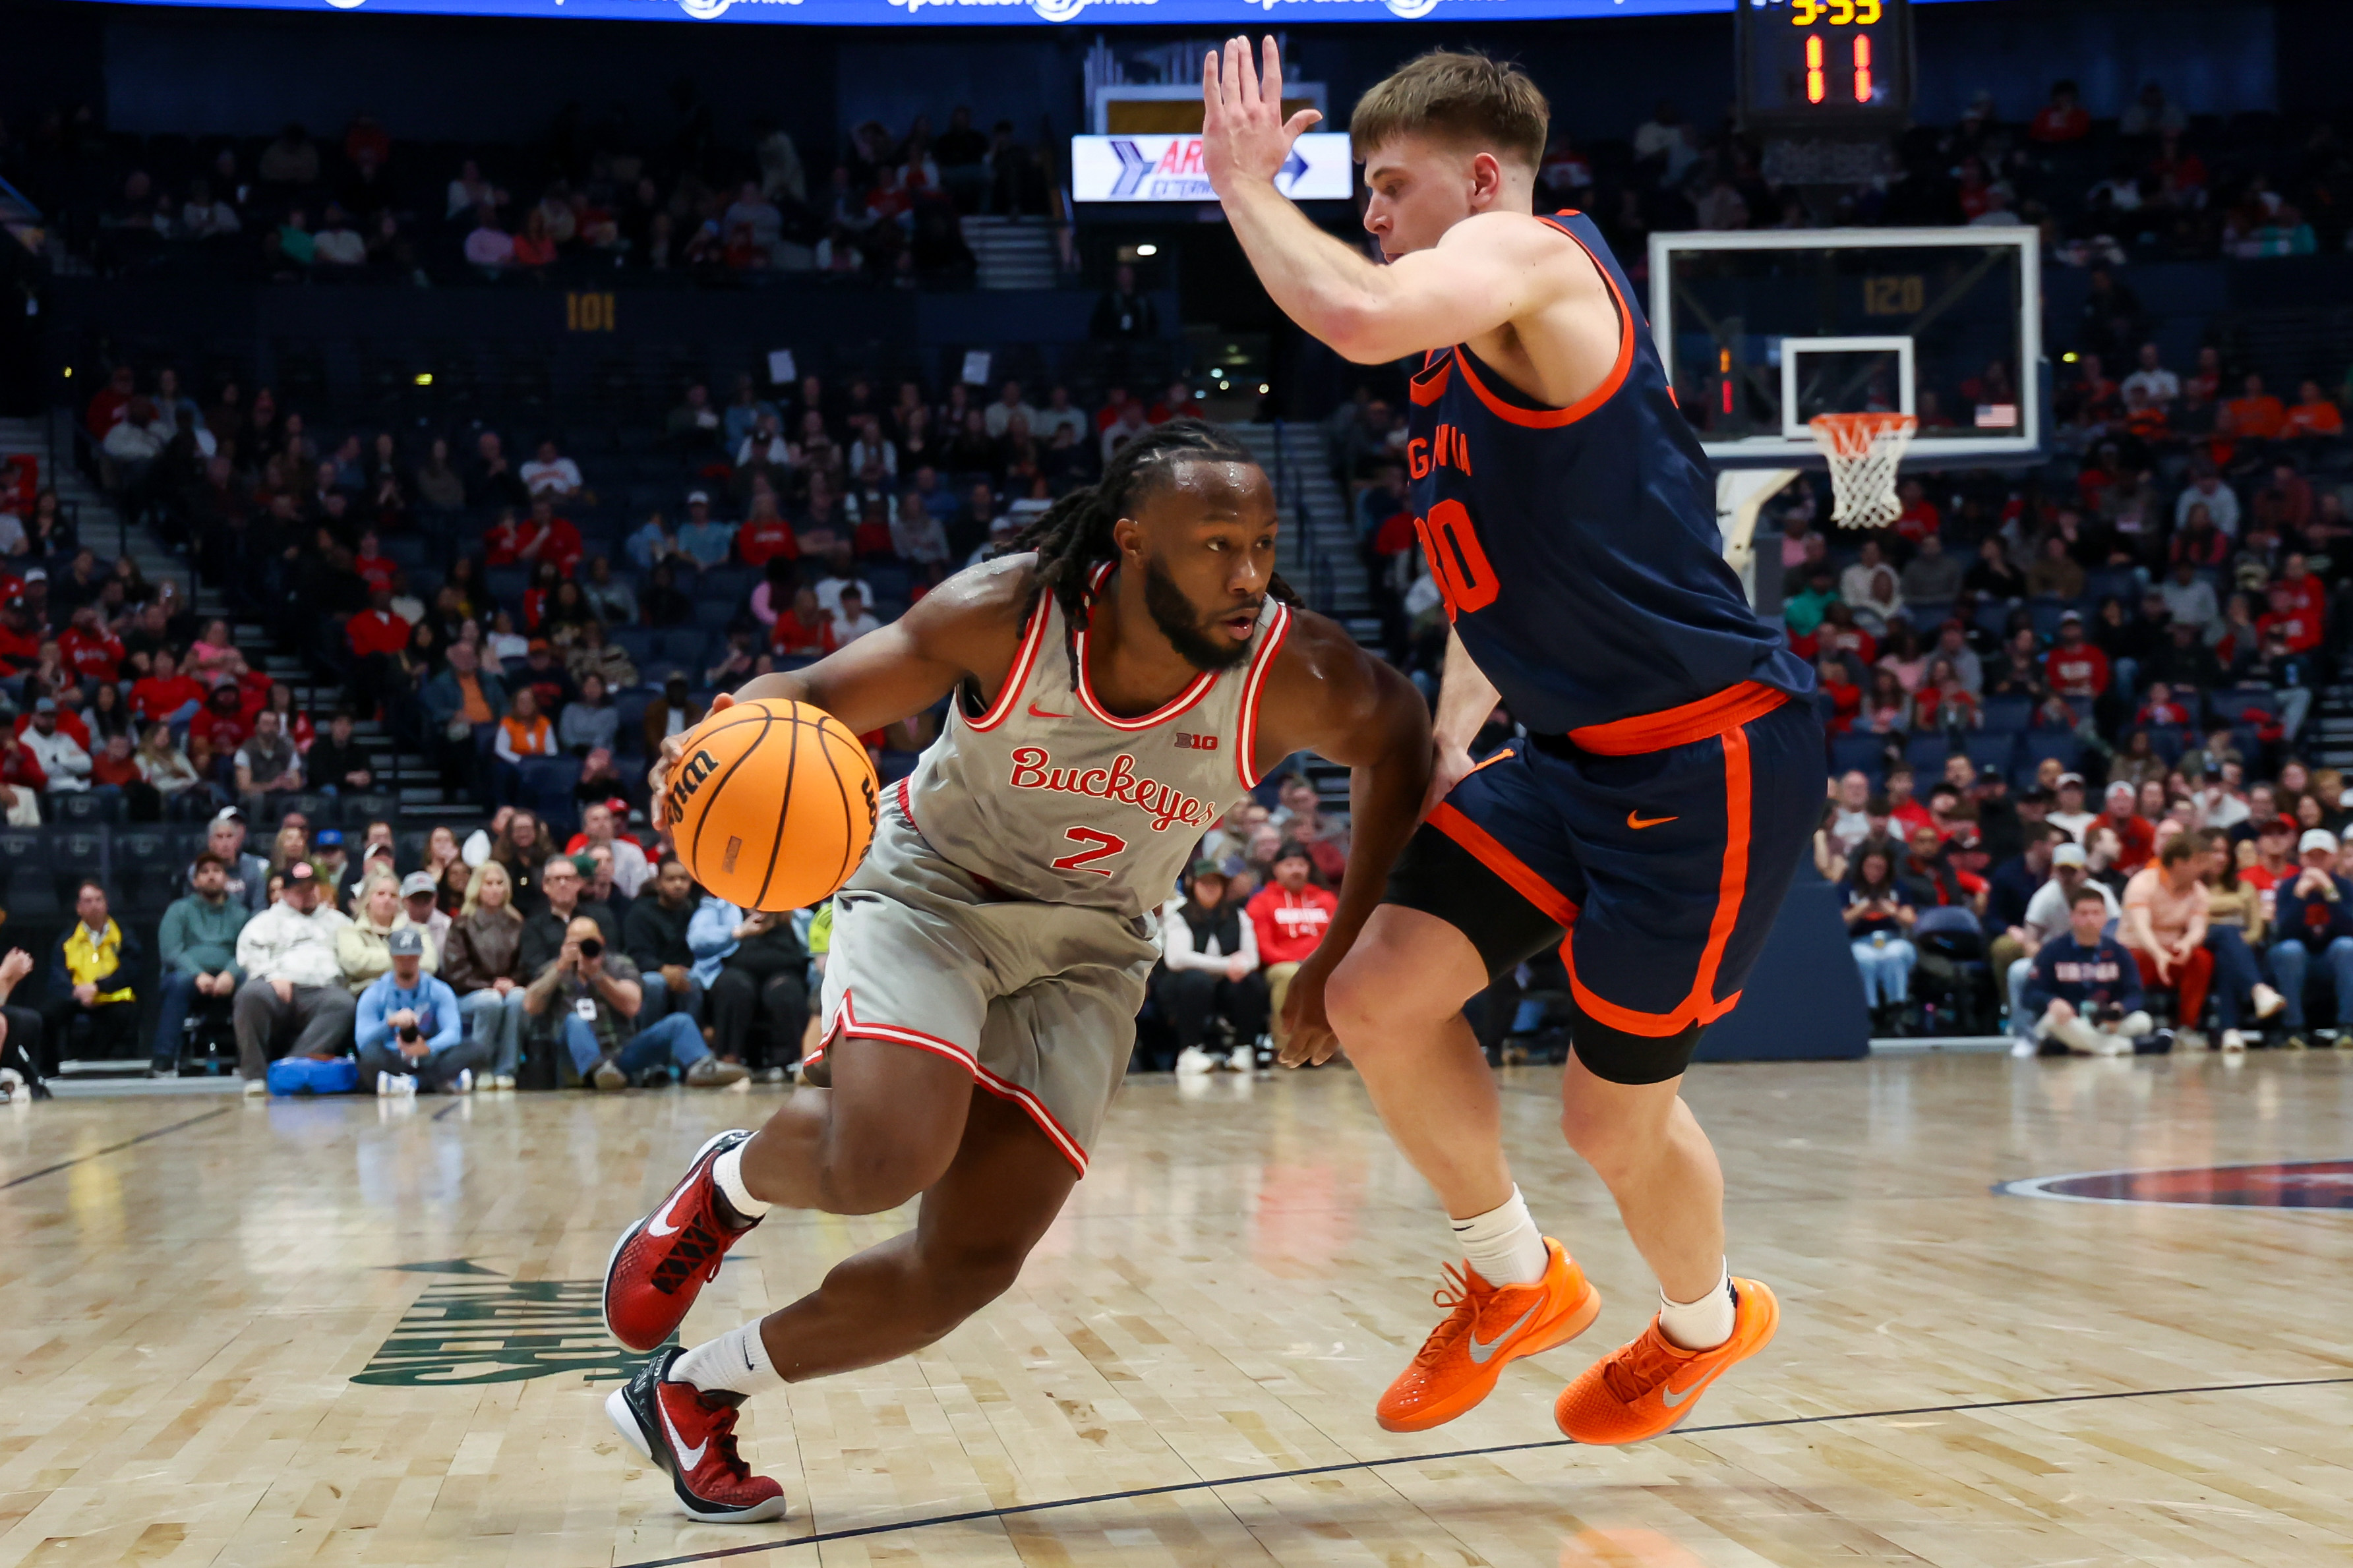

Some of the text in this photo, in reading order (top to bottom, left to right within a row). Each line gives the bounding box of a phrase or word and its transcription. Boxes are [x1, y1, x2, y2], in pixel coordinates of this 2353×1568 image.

[1806, 34, 1872, 103] 11
[1009, 746, 1216, 832] Buckeyes
[1050, 825, 1129, 879] 2
